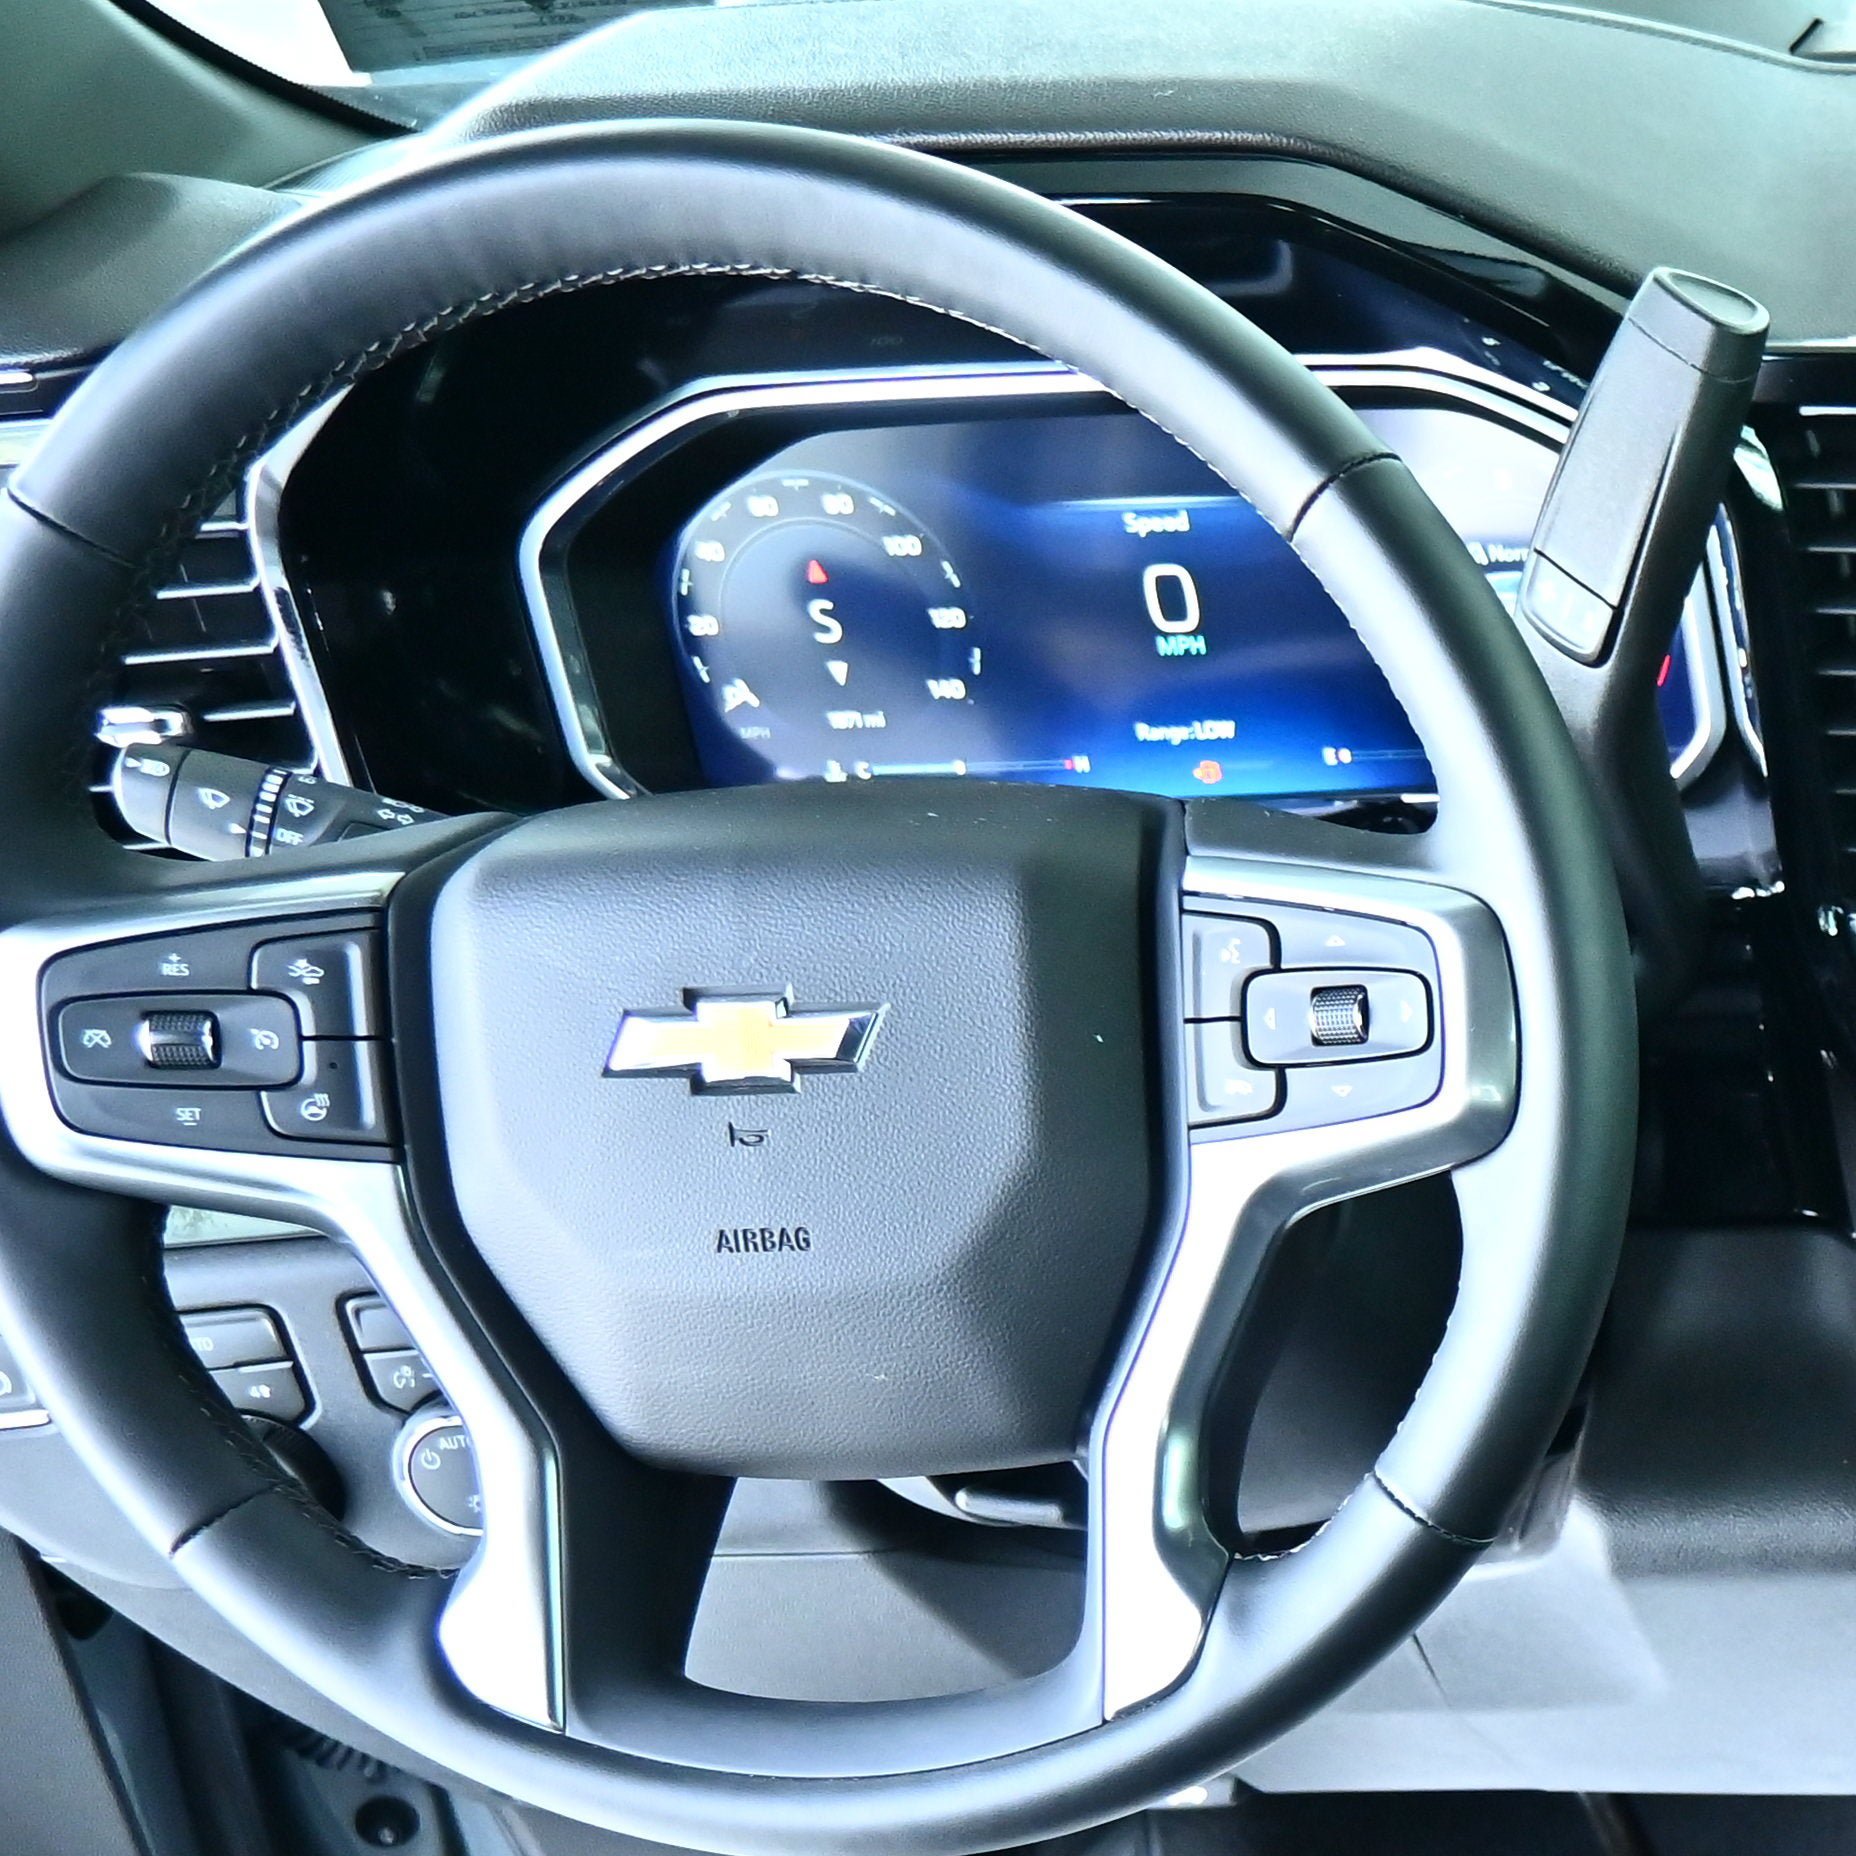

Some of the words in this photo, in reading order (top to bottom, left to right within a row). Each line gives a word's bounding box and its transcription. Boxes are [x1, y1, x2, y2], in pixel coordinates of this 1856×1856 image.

[1122, 508, 1190, 537] Speed
[1143, 563, 1200, 634] 0
[807, 598, 843, 644] S
[1155, 634, 1207, 656] MPH
[275, 827, 305, 846] OFF
[161, 962, 190, 977] RES
[175, 1107, 202, 1122] SET
[716, 1225, 813, 1254] AIRBAG
